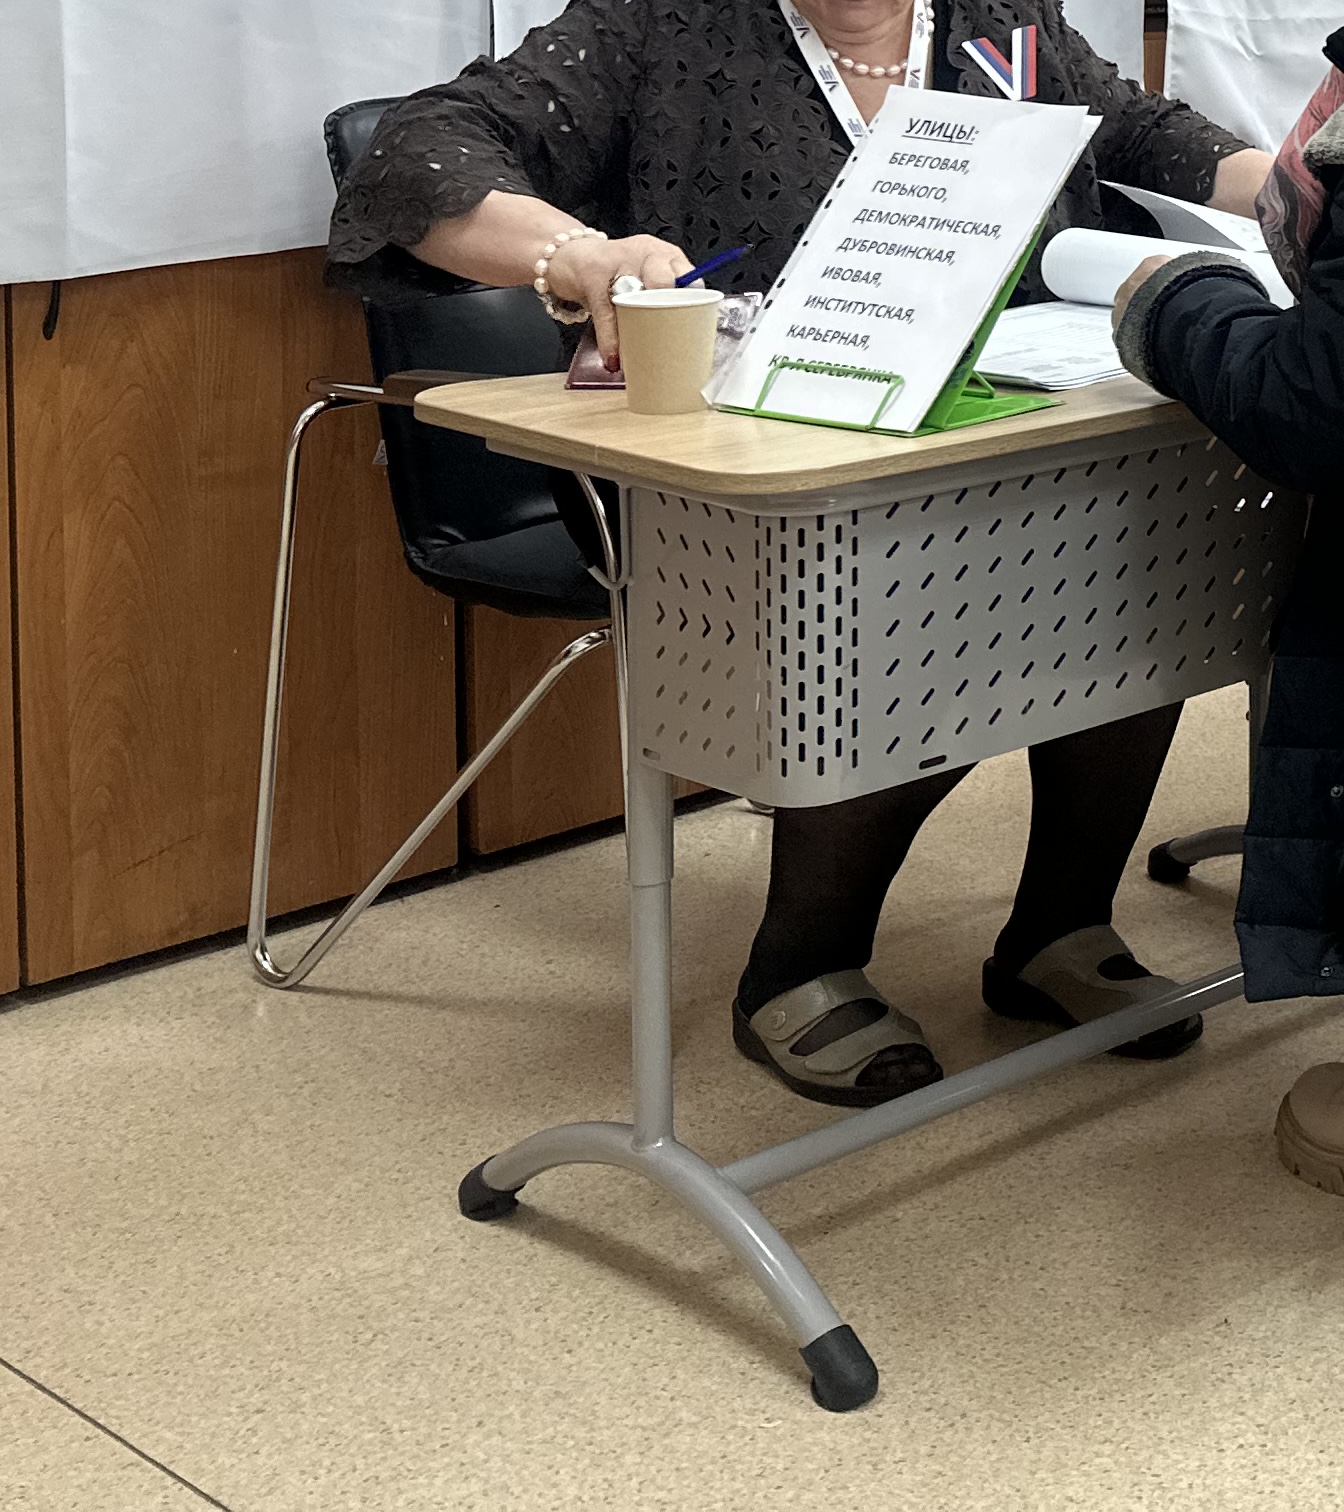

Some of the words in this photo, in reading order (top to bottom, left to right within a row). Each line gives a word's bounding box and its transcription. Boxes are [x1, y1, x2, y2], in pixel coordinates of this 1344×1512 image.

[905, 118, 979, 143] УЛИЦЫ:
[889, 152, 970, 175] БЕРЕГОВАЯ,
[872, 180, 948, 203] ГОРЬКОГО,
[852, 208, 1001, 239] ДЕМОКРАТИЧЕСКАЯ,
[836, 237, 956, 266] ДУБРОВИНСКАЯ,
[821, 266, 882, 288] ИВОВАЯ,
[803, 294, 915, 324] ИНСТИТУТСКАЯ,
[786, 324, 871, 351] КАРЬЕРНАЯ,
